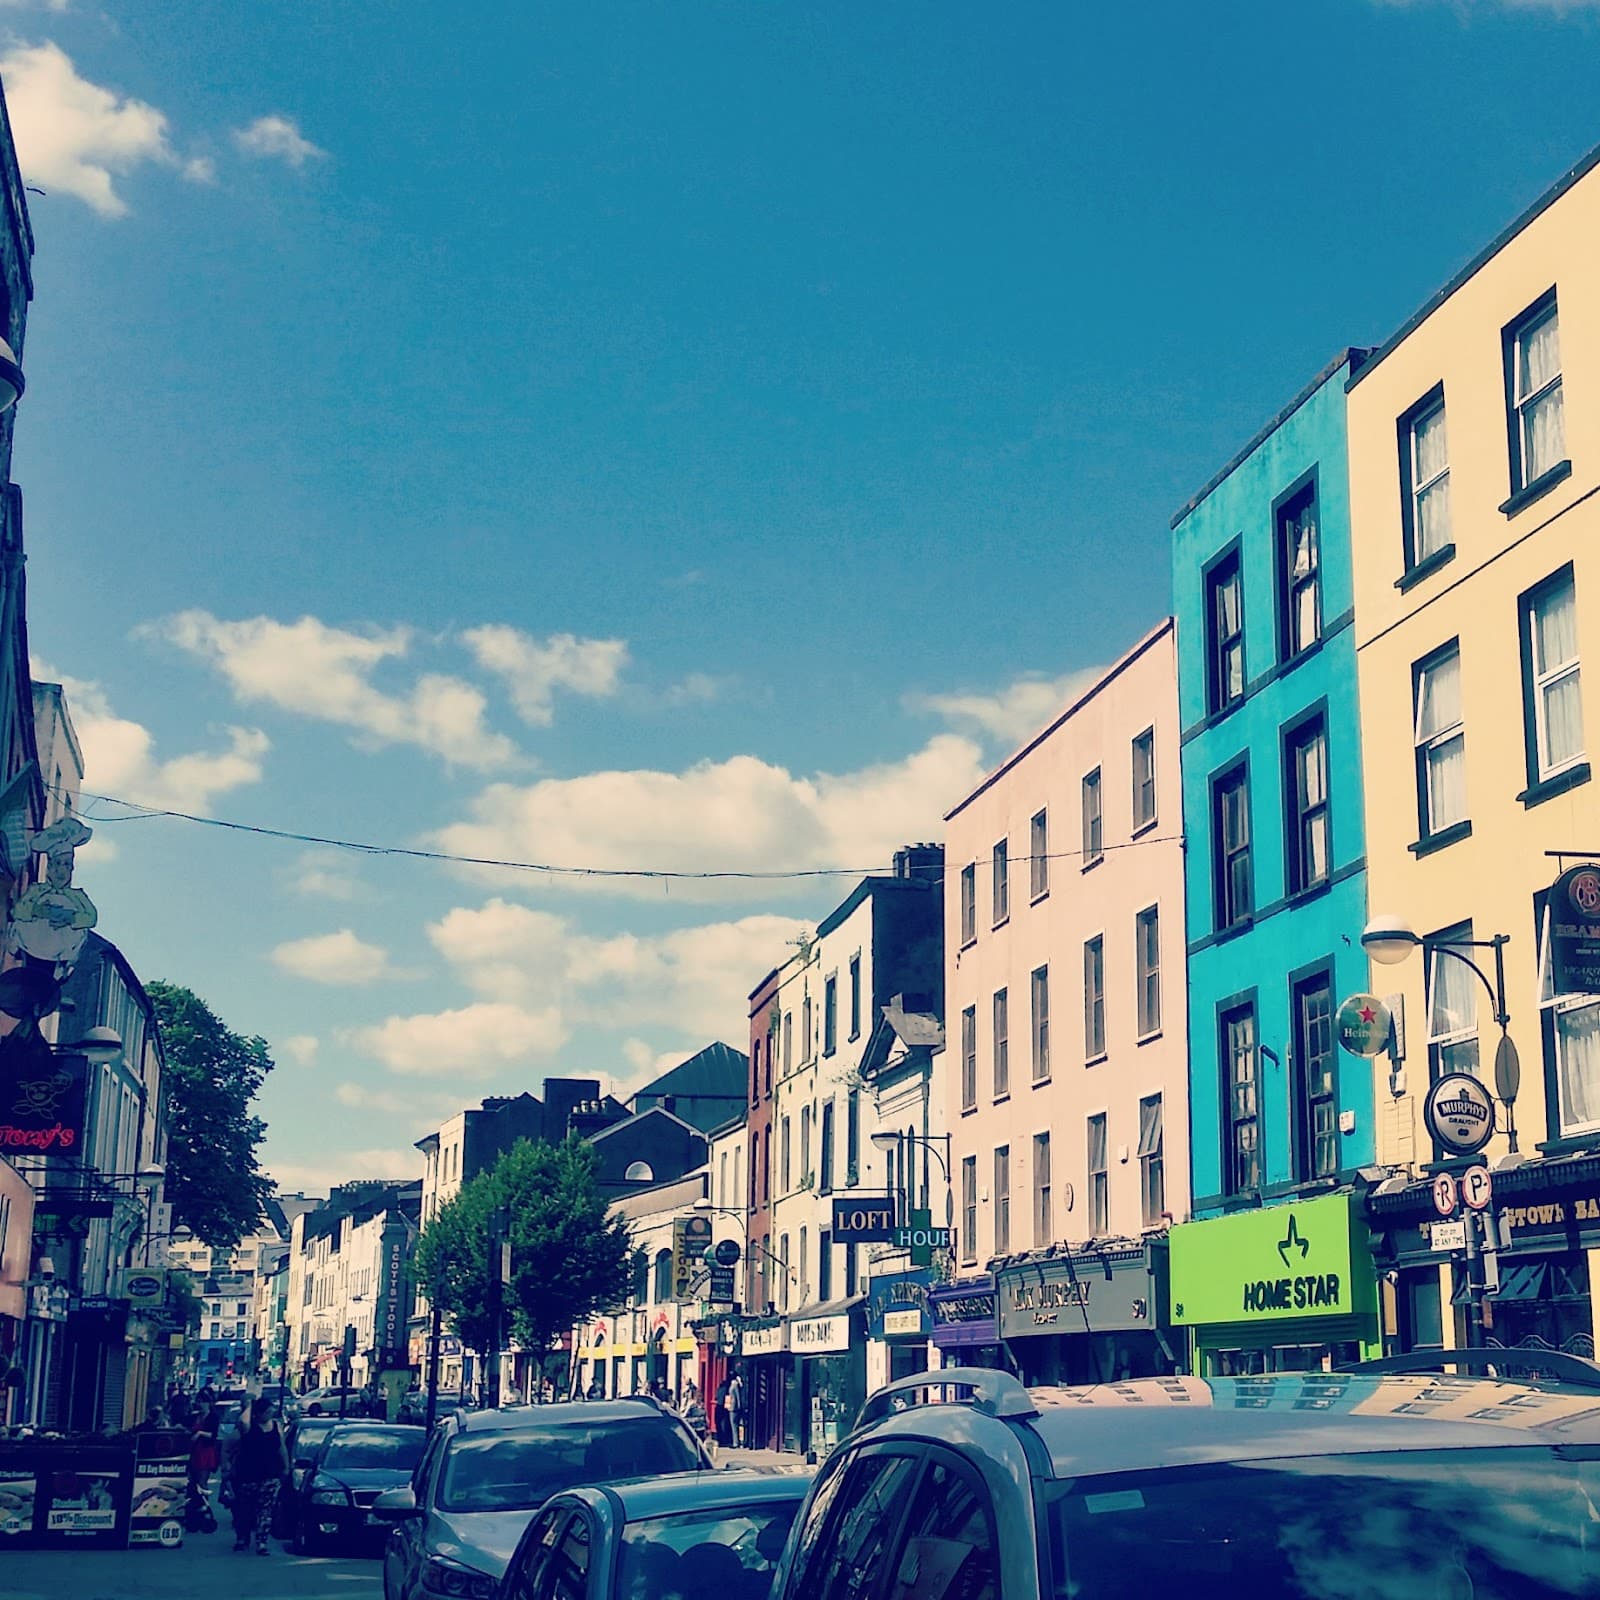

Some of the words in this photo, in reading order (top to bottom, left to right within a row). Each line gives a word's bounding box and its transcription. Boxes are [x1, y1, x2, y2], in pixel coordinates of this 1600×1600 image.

[837, 1210, 891, 1231] LOFT
[390, 1244, 400, 1296] SCOTTS
[81, 1300, 108, 1309] NCBI
[1243, 1279, 1292, 1313] HOME
[1294, 1273, 1340, 1310] STAR
[386, 1303, 396, 1349] TOOLS
